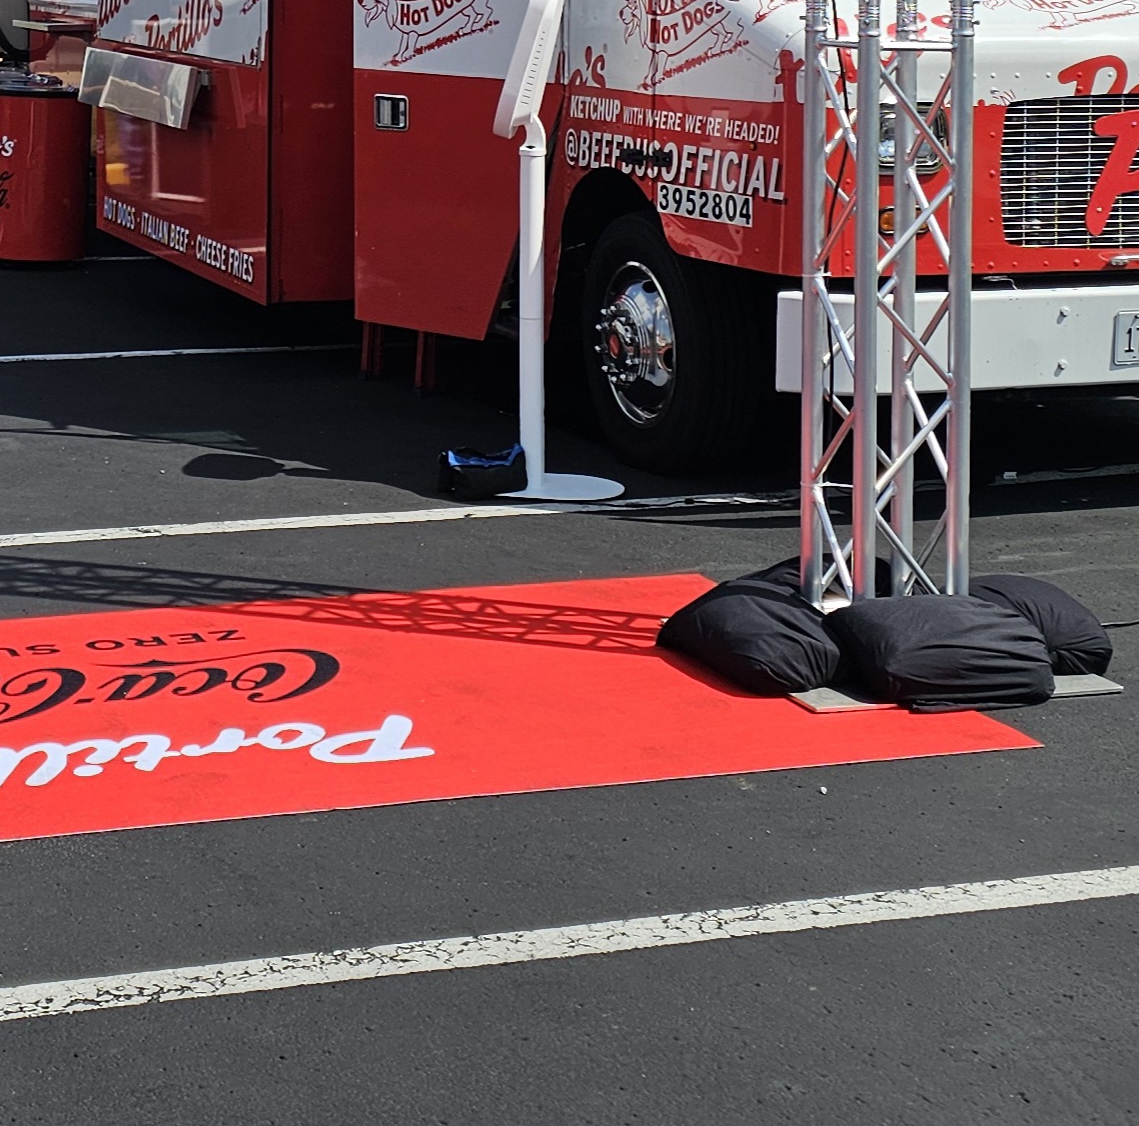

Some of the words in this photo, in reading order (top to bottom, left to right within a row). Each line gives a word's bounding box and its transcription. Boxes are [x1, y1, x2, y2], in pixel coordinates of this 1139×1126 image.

[400, 3, 429, 26] HOT
[649, 17, 679, 45] HOT
[681, 0, 726, 35] DOGS
[570, 95, 621, 123] KETCHUP
[623, 106, 644, 124] WITH
[645, 109, 682, 131] WHERE
[685, 113, 721, 137] WE'RE
[724, 119, 780, 145] HEADED!
[659, 185, 752, 225] 3952804
[103, 195, 117, 222] HOT
[117, 201, 136, 230] DOGS
[141, 211, 170, 245] ITALIAN
[169, 223, 190, 253] BEEF
[196, 234, 227, 271] CHEESE
[228, 247, 255, 283] FRIES
[86, 629, 246, 651] ZERO
